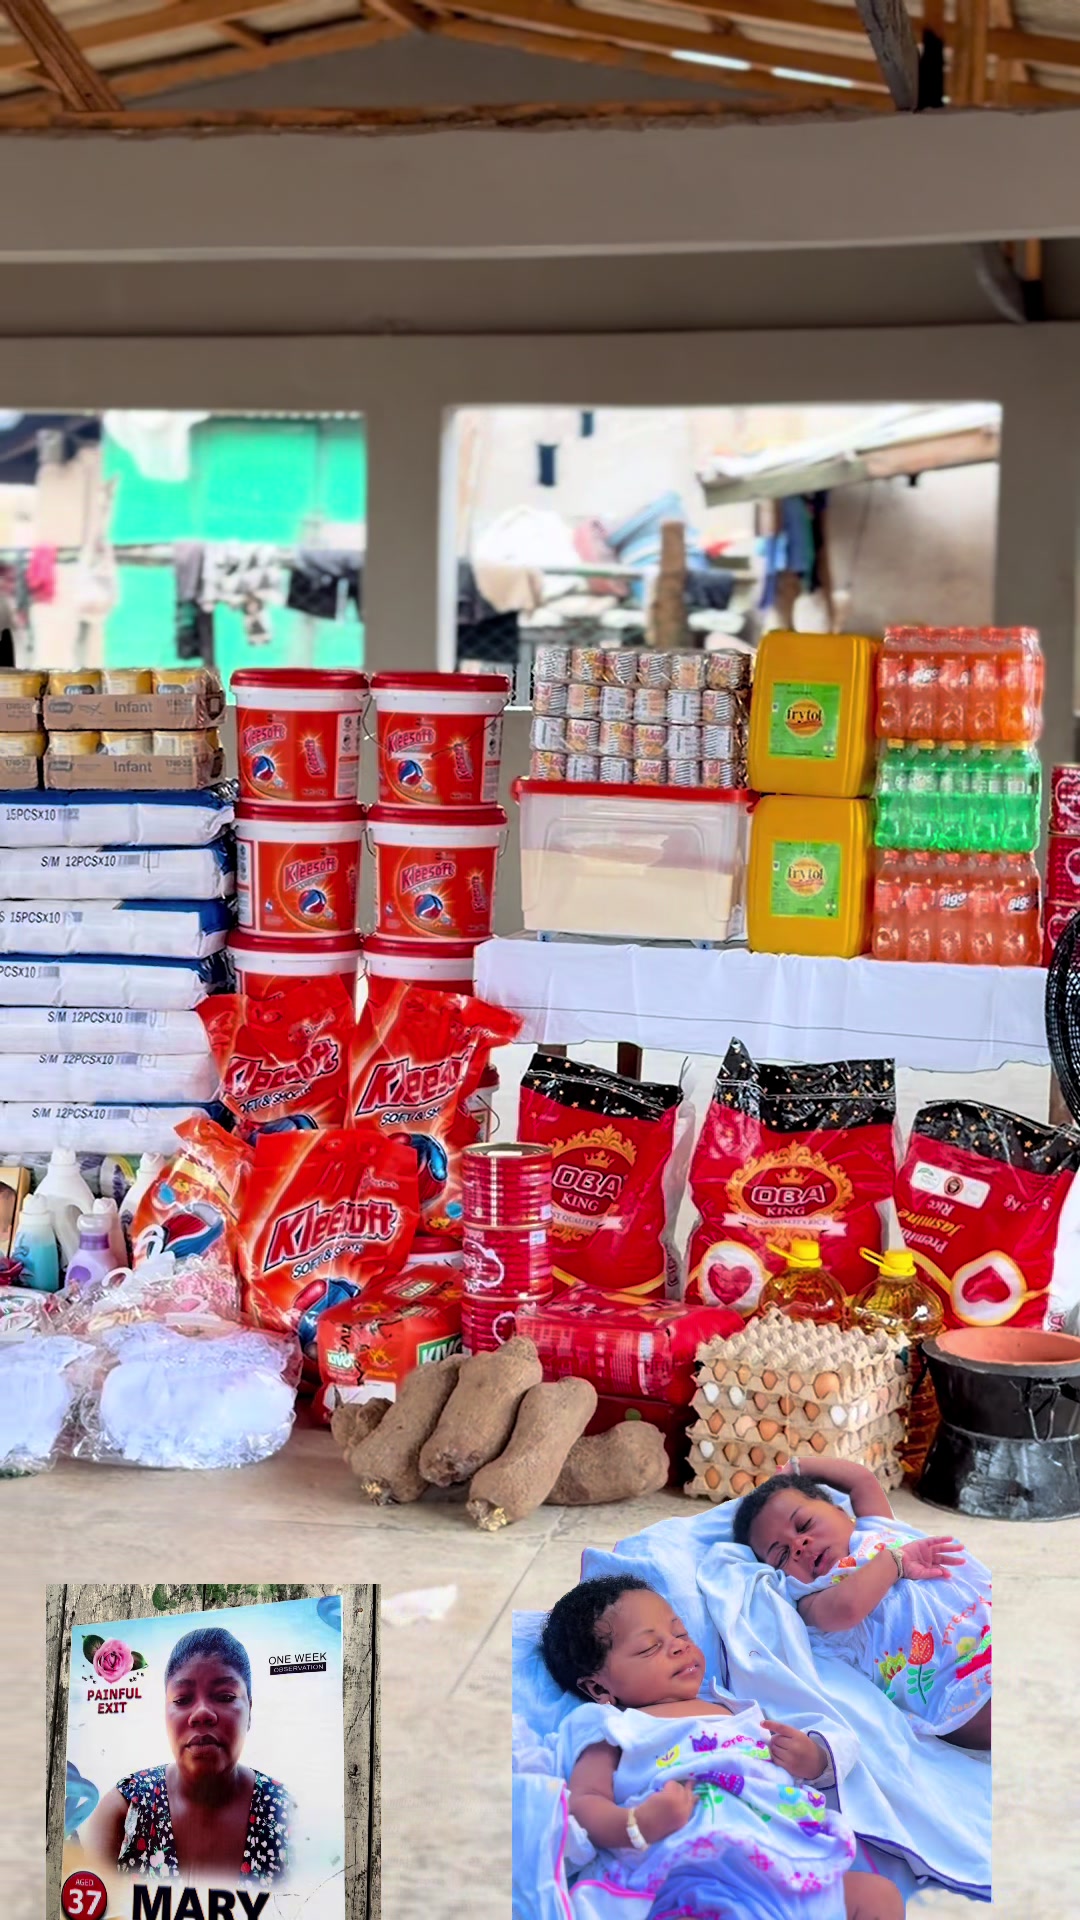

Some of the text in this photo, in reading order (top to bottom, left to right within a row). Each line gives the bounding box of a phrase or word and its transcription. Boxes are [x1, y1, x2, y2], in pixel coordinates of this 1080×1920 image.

[113, 701, 153, 713] Infant
[786, 707, 822, 723] frytol
[113, 761, 153, 773] Infant
[41, 856, 60, 867] S/M
[284, 856, 338, 889] Kleesoft
[401, 861, 456, 893] Kleesoft
[47, 1011, 67, 1023] S/M
[39, 1053, 59, 1064] S/M
[32, 1107, 51, 1119] S/M
[553, 1165, 623, 1200] OBA
[561, 1193, 599, 1212] KING
[752, 1185, 826, 1206] OBA
[766, 1206, 805, 1216] KING
[926, 1199, 955, 1217] Rice
[897, 1207, 966, 1238] Jasmine
[901, 1226, 949, 1254] Premiu
[268, 1652, 327, 1665] ONE WEEK
[273, 1664, 324, 1673] OBSERVATION
[87, 1687, 142, 1701] PAINFUL
[97, 1702, 127, 1715] EXIT
[75, 1878, 94, 1887] AGED
[68, 1888, 102, 1916] 37
[131, 1884, 270, 1920] MARY
